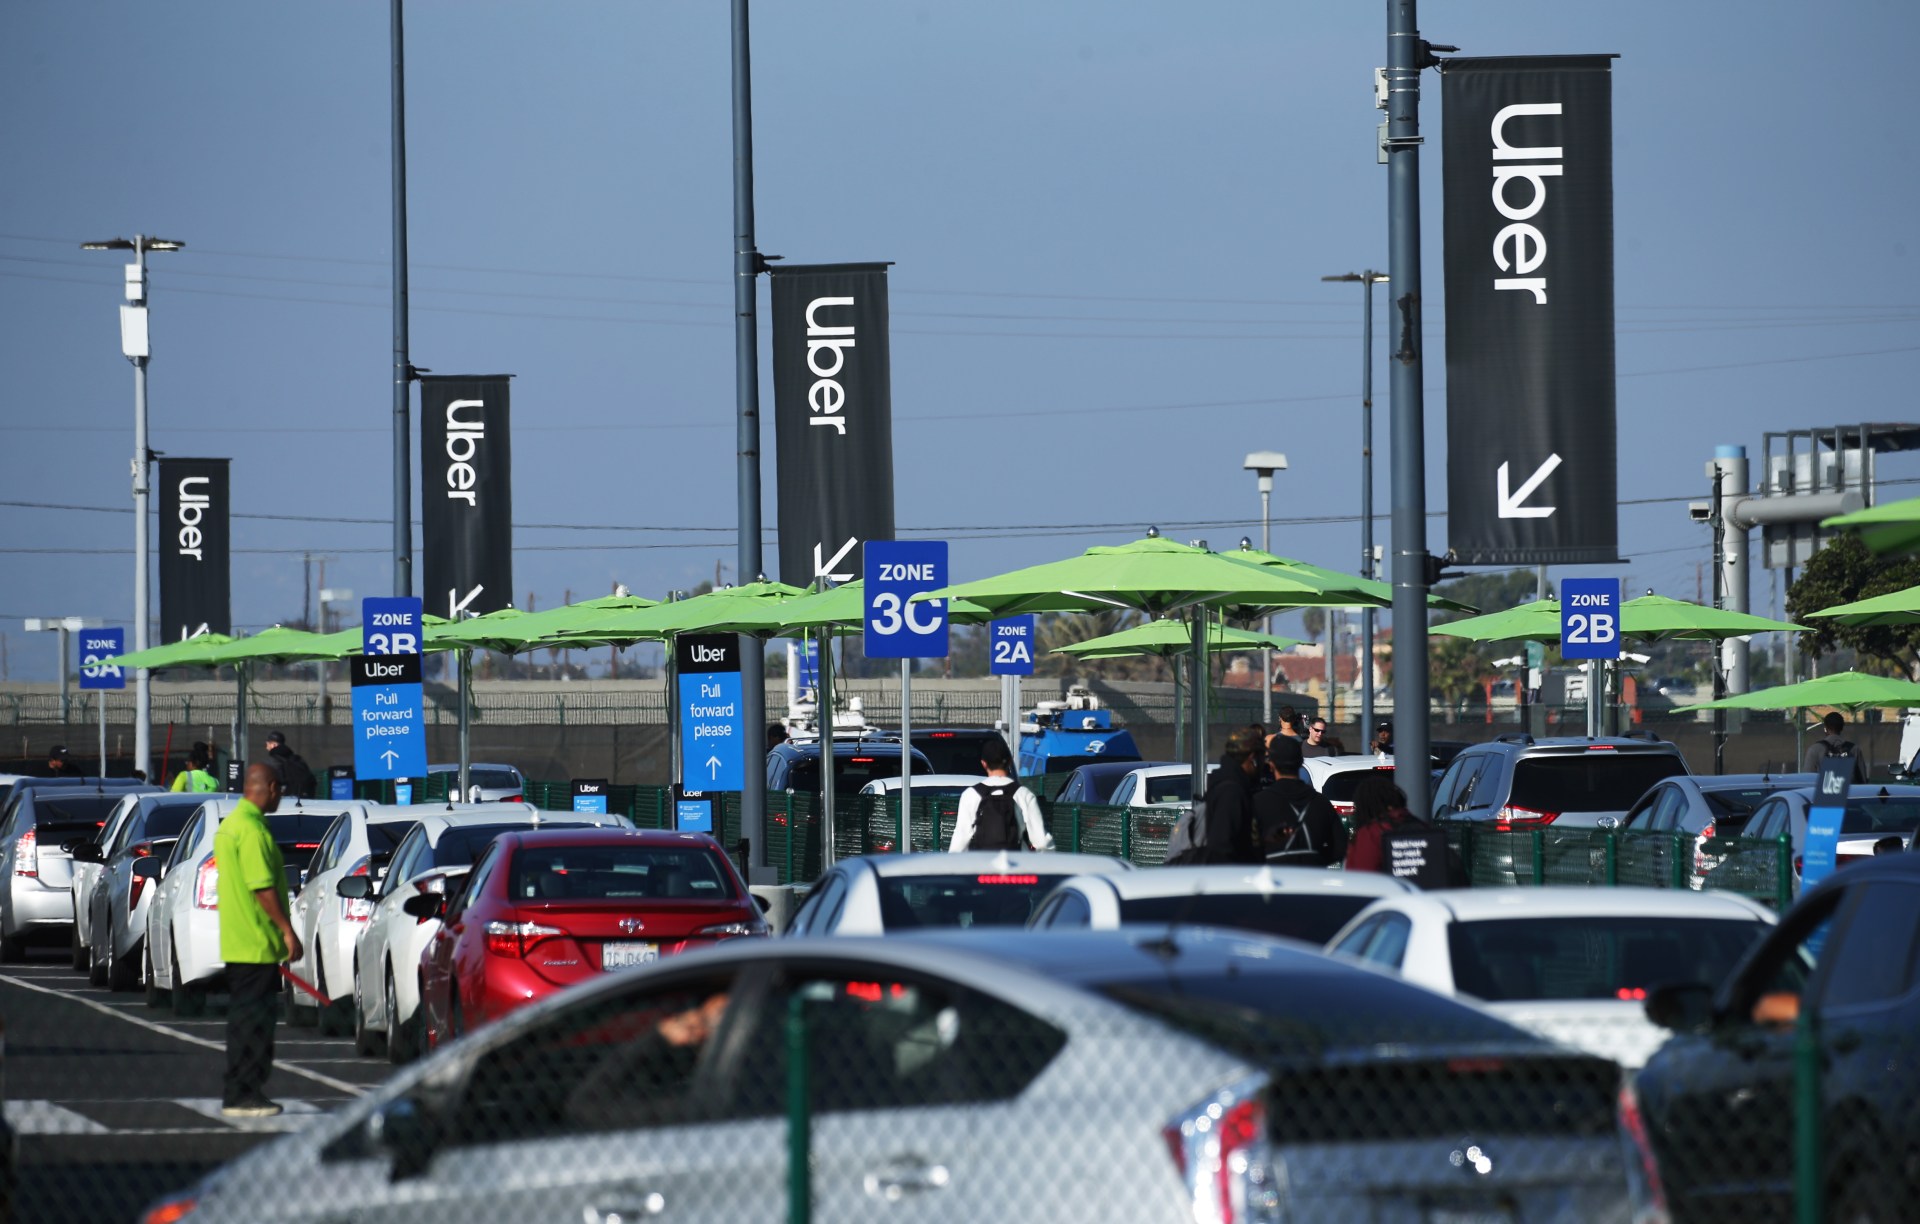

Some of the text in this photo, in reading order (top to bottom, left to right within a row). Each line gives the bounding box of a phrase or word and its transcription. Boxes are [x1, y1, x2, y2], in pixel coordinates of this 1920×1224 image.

[1490, 103, 1563, 304] Uber
[805, 296, 855, 435] Uber
[445, 399, 485, 507] Uber
[178, 476, 210, 561] Uber
[879, 564, 934, 581] ZONE
[1571, 594, 1610, 607] ZONE
[372, 613, 413, 626] ZONE
[871, 592, 943, 635] 3C
[997, 626, 1027, 636] ZONE
[1567, 613, 1616, 644] 2B
[86, 640, 117, 650] ZONE
[691, 644, 726, 663] Uber
[994, 641, 1031, 663] 2A
[83, 654, 122, 678] 3A
[365, 662, 404, 677] Uber
[375, 693, 398, 705] Pull
[701, 684, 721, 698] Pull
[362, 708, 413, 721] forward
[690, 702, 734, 718] forward
[366, 725, 410, 740] please
[694, 723, 732, 741] please
[579, 784, 600, 793] Uber
[1822, 771, 1845, 795] Uber
